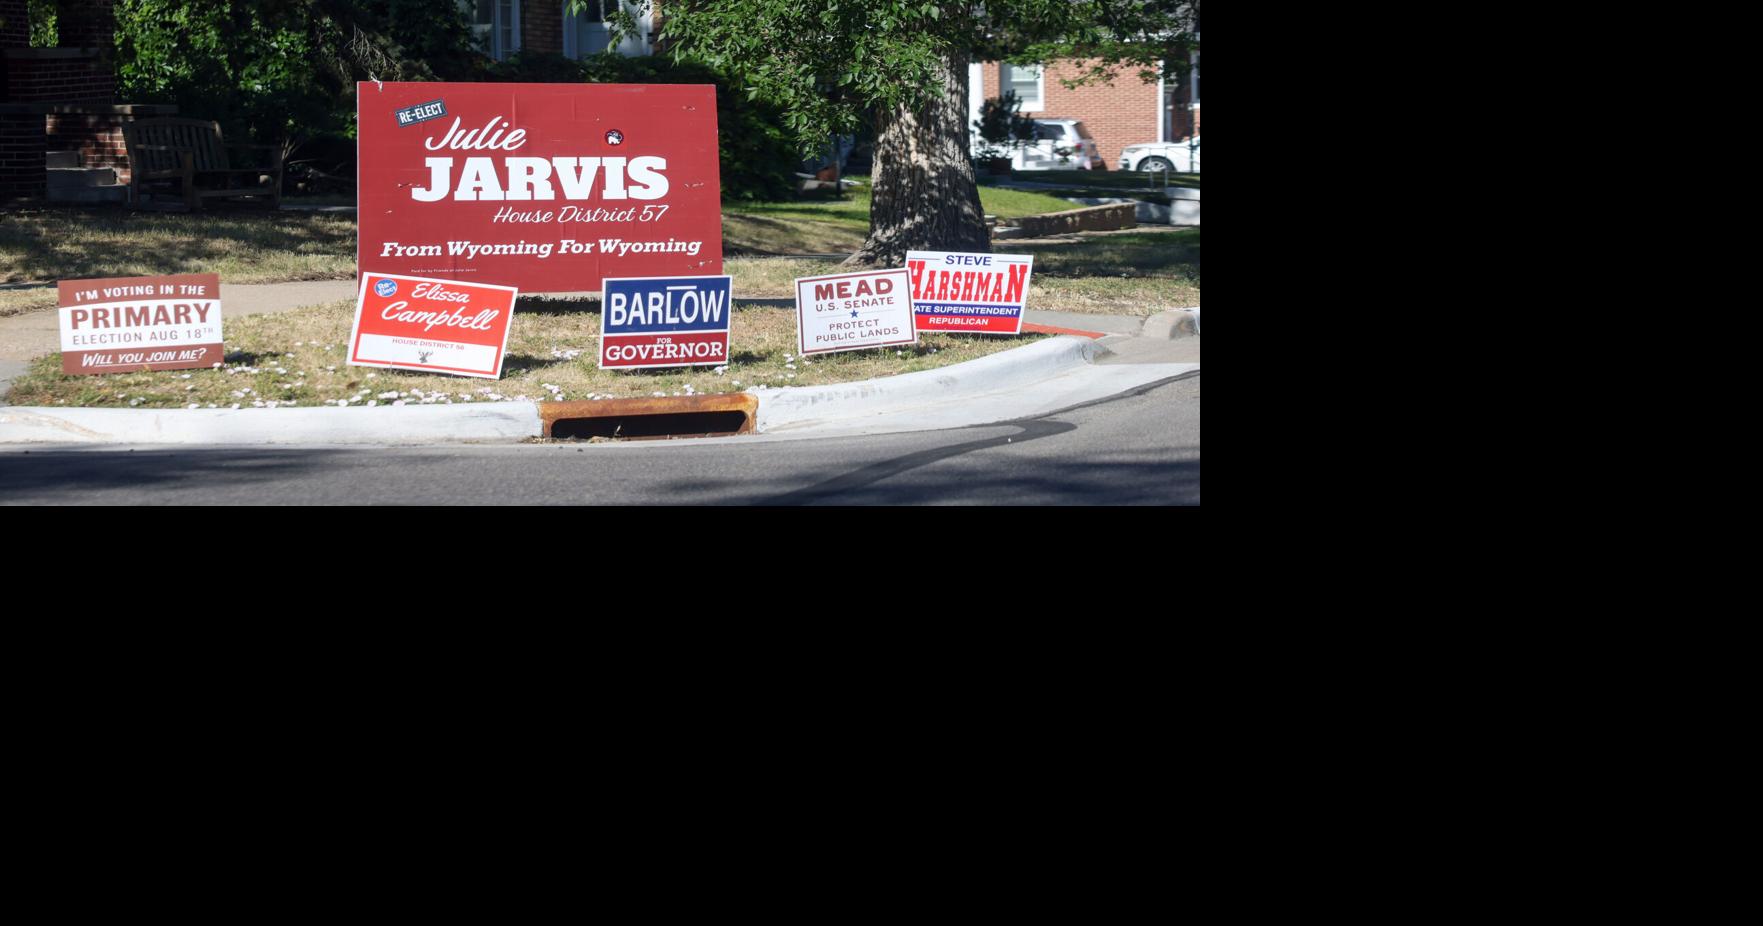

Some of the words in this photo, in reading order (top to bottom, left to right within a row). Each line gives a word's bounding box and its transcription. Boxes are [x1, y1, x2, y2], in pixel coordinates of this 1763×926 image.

[399, 102, 443, 124] RE-ELECT
[425, 115, 527, 151] Julie
[411, 156, 670, 202] JARVIS
[493, 206, 554, 223] House
[557, 205, 636, 223] District
[639, 204, 669, 222] 57
[380, 241, 442, 257] From
[447, 239, 554, 260] Wyoming
[558, 239, 595, 254] For
[598, 238, 703, 256] Wyoming
[945, 255, 992, 266] STEVE
[815, 278, 894, 302] MEAD
[907, 260, 1028, 303] HARSHMAN
[75, 289, 99, 301] I'M
[103, 285, 154, 298] VOTING
[160, 284, 174, 295] IN
[180, 284, 206, 295] THE
[411, 282, 471, 304] Elissa
[610, 289, 725, 326] BARLOW
[816, 302, 839, 312] U.S.
[844, 296, 895, 310] SENATE
[913, 305, 932, 313] ATE
[933, 305, 1018, 315] SUPERINTENDENT
[70, 302, 212, 330] PRIMARY
[381, 301, 500, 332] Campbell
[829, 319, 880, 331] PROTECT
[928, 317, 989, 326] REPUBLICAN
[72, 331, 143, 345] ELECTION
[149, 330, 179, 342] AUG
[392, 338, 419, 346] HOUSE
[419, 340, 455, 350] DISTRICT
[816, 331, 856, 343] PUBLIC
[860, 326, 900, 338] LANDS
[82, 353, 113, 367] WILL
[118, 352, 145, 364] YOU
[146, 350, 176, 362] JOIN
[178, 348, 207, 361] ME?
[605, 341, 723, 361] GOVERNOR
